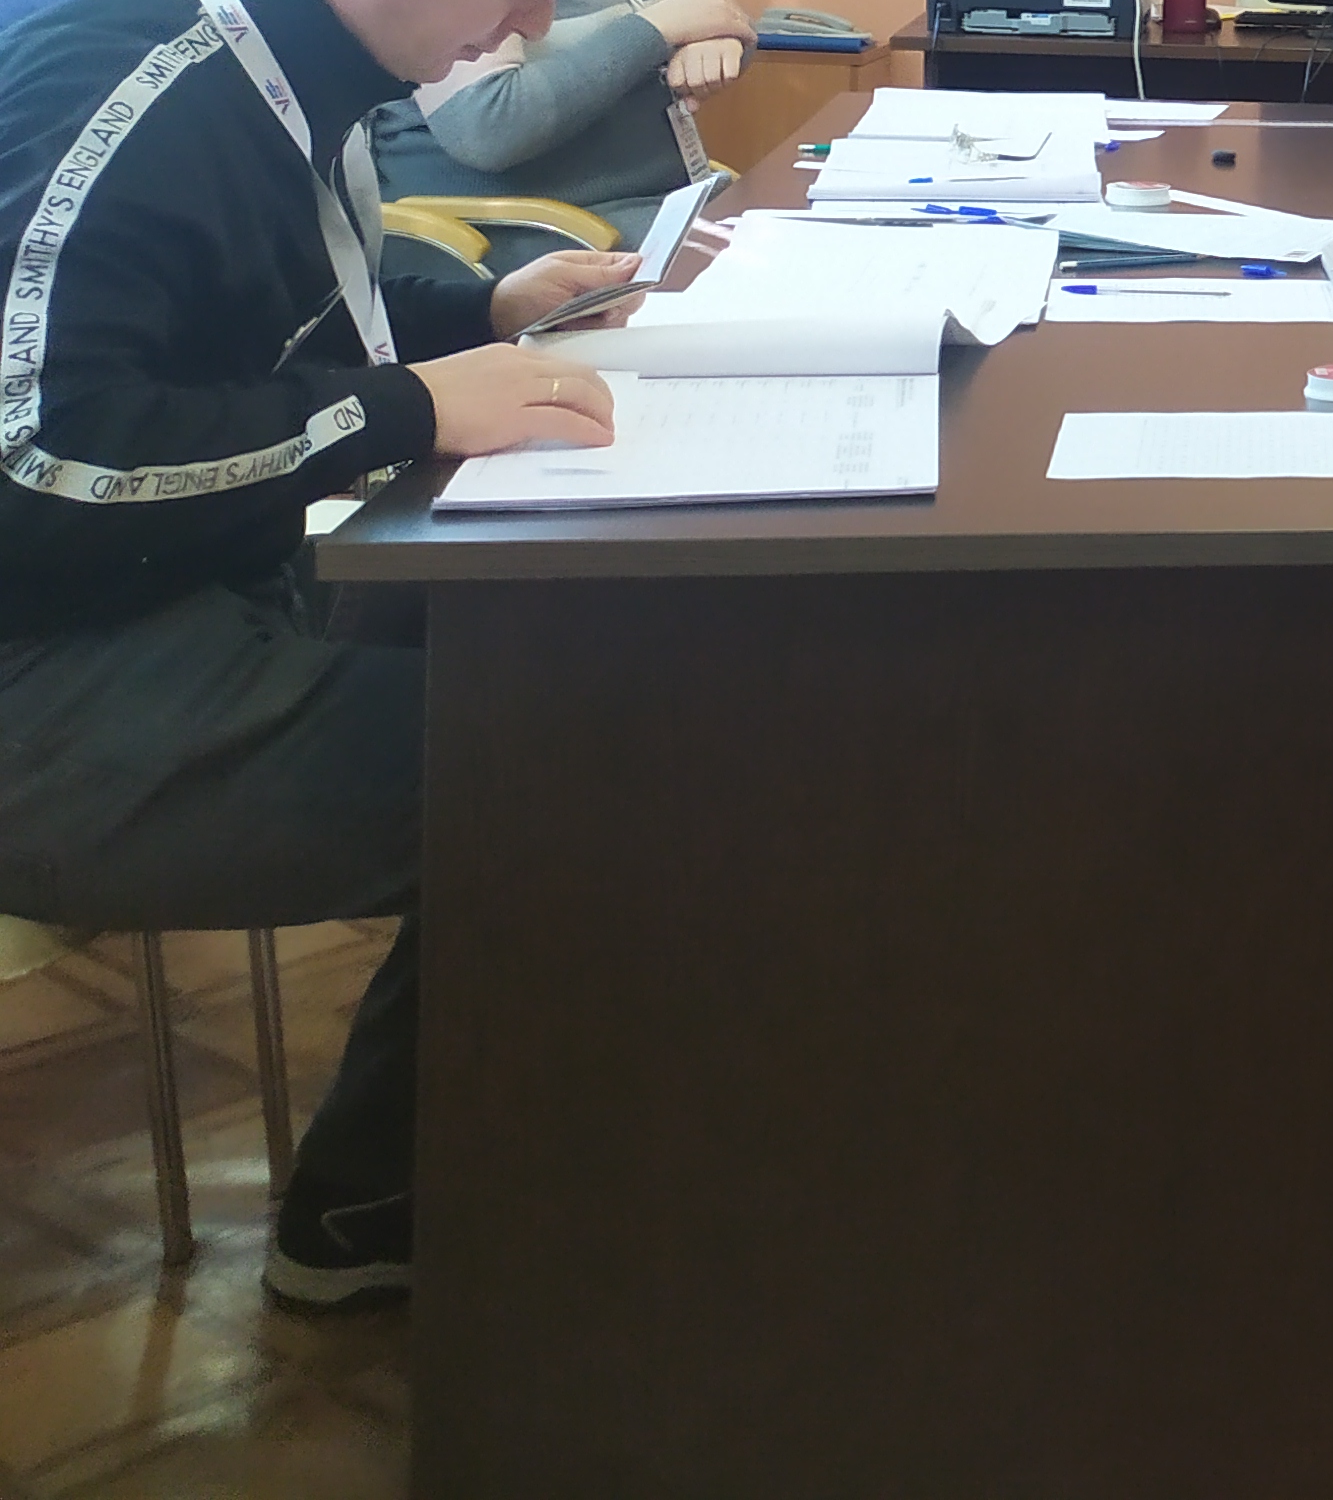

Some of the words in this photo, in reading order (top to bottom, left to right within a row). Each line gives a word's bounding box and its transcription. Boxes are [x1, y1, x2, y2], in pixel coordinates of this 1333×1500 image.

[15, 195, 74, 300] SMITHY'S
[56, 101, 134, 191] ENGLAND
[3, 312, 41, 424] ENGLAND
[90, 467, 219, 500] ENGLAND
